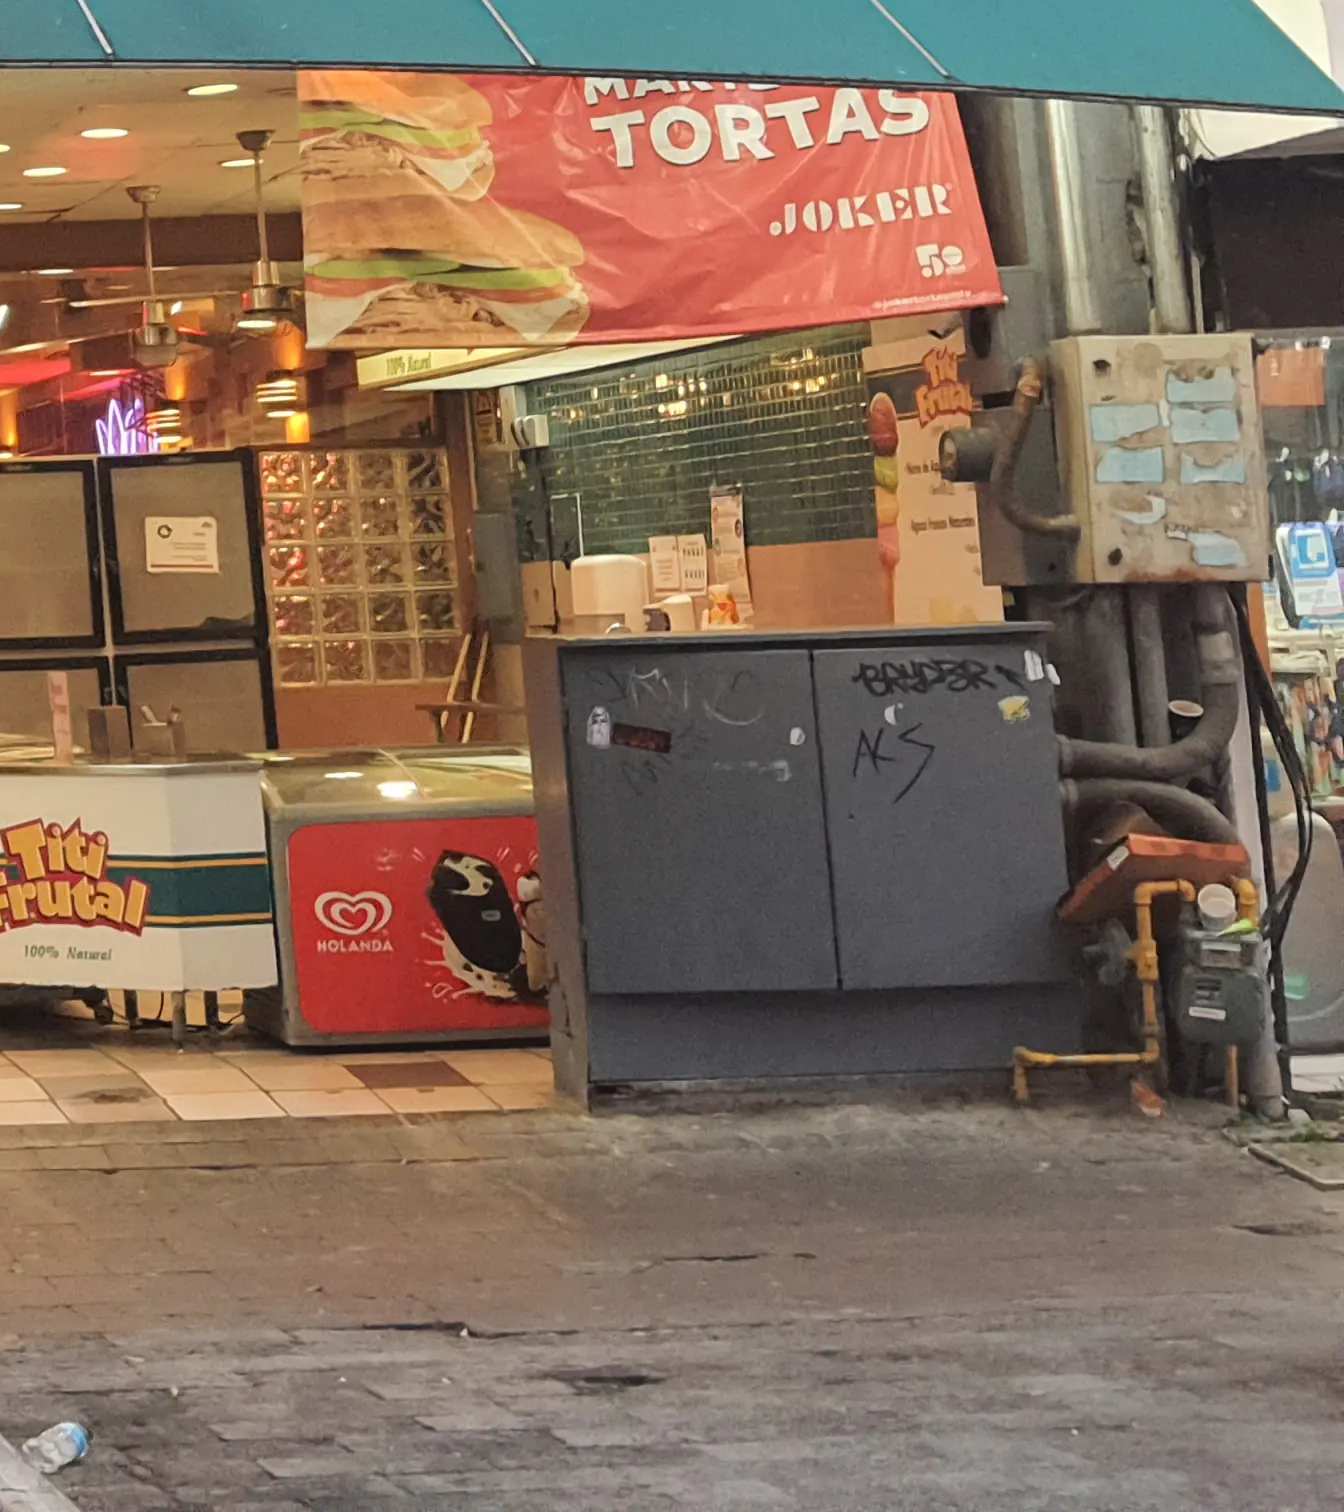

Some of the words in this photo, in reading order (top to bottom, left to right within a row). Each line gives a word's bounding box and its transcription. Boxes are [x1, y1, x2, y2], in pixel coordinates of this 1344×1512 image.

[590, 88, 930, 168] TORTAS
[769, 184, 953, 237] JOKER
[1, 819, 109, 881] Titi
[24, 945, 60, 959] 100%
[67, 946, 113, 961] Natural
[317, 939, 394, 953] HOLANDA
